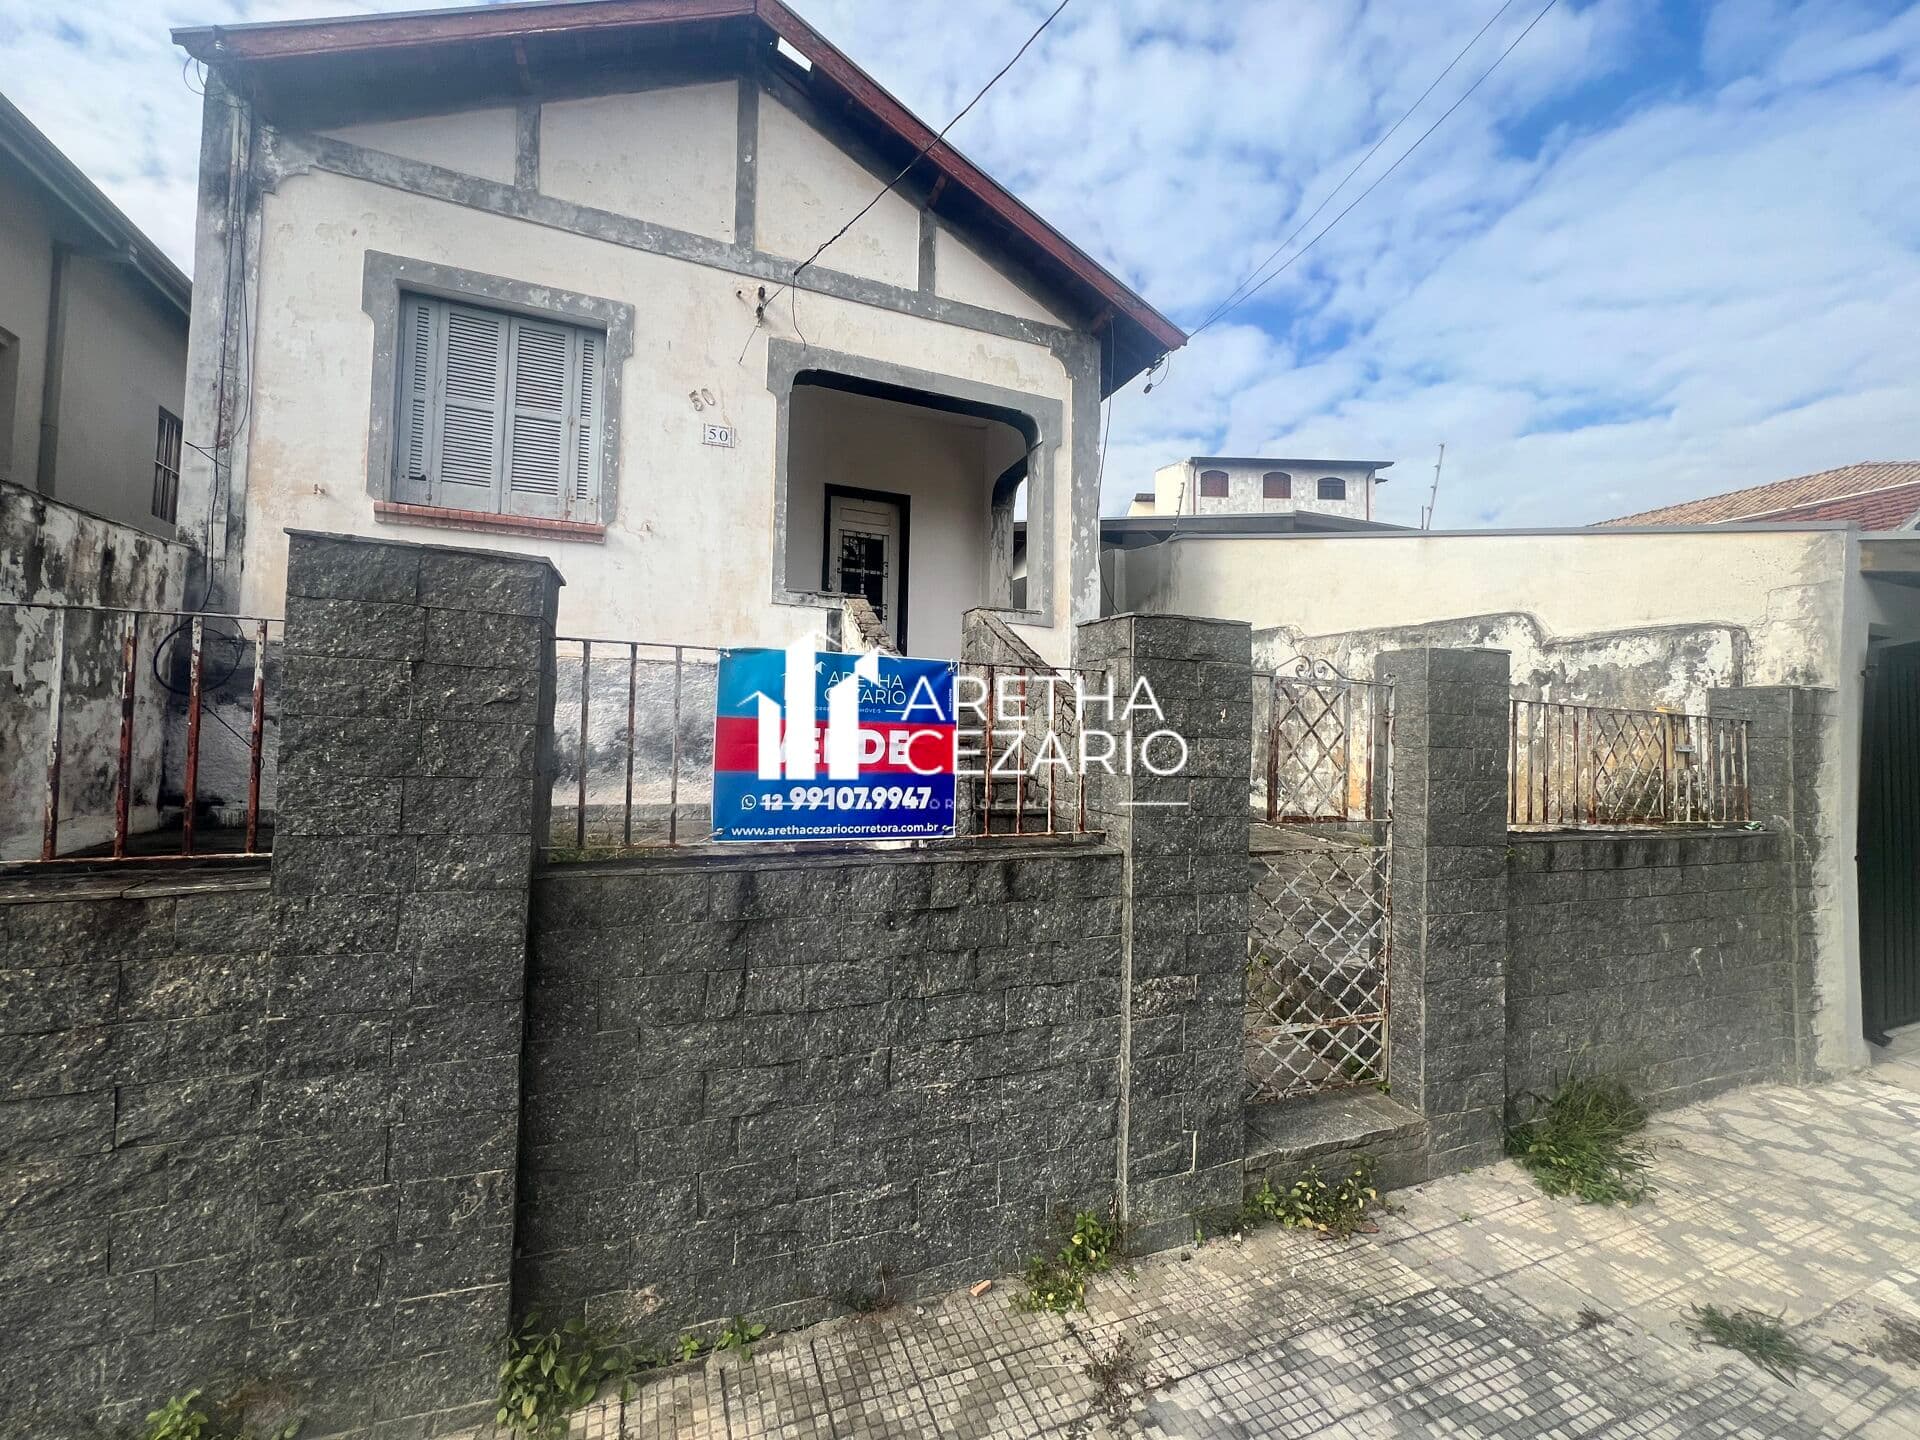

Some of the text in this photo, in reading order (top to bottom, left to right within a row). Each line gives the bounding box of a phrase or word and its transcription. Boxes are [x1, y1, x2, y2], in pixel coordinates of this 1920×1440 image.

[708, 428, 729, 442] 50
[828, 671, 904, 689] AEHA
[824, 689, 906, 705] CARIO
[762, 793, 784, 811] 12
[789, 786, 932, 811] 99107.9947
[731, 823, 939, 836] www.arethacezariocorretora.com.br
